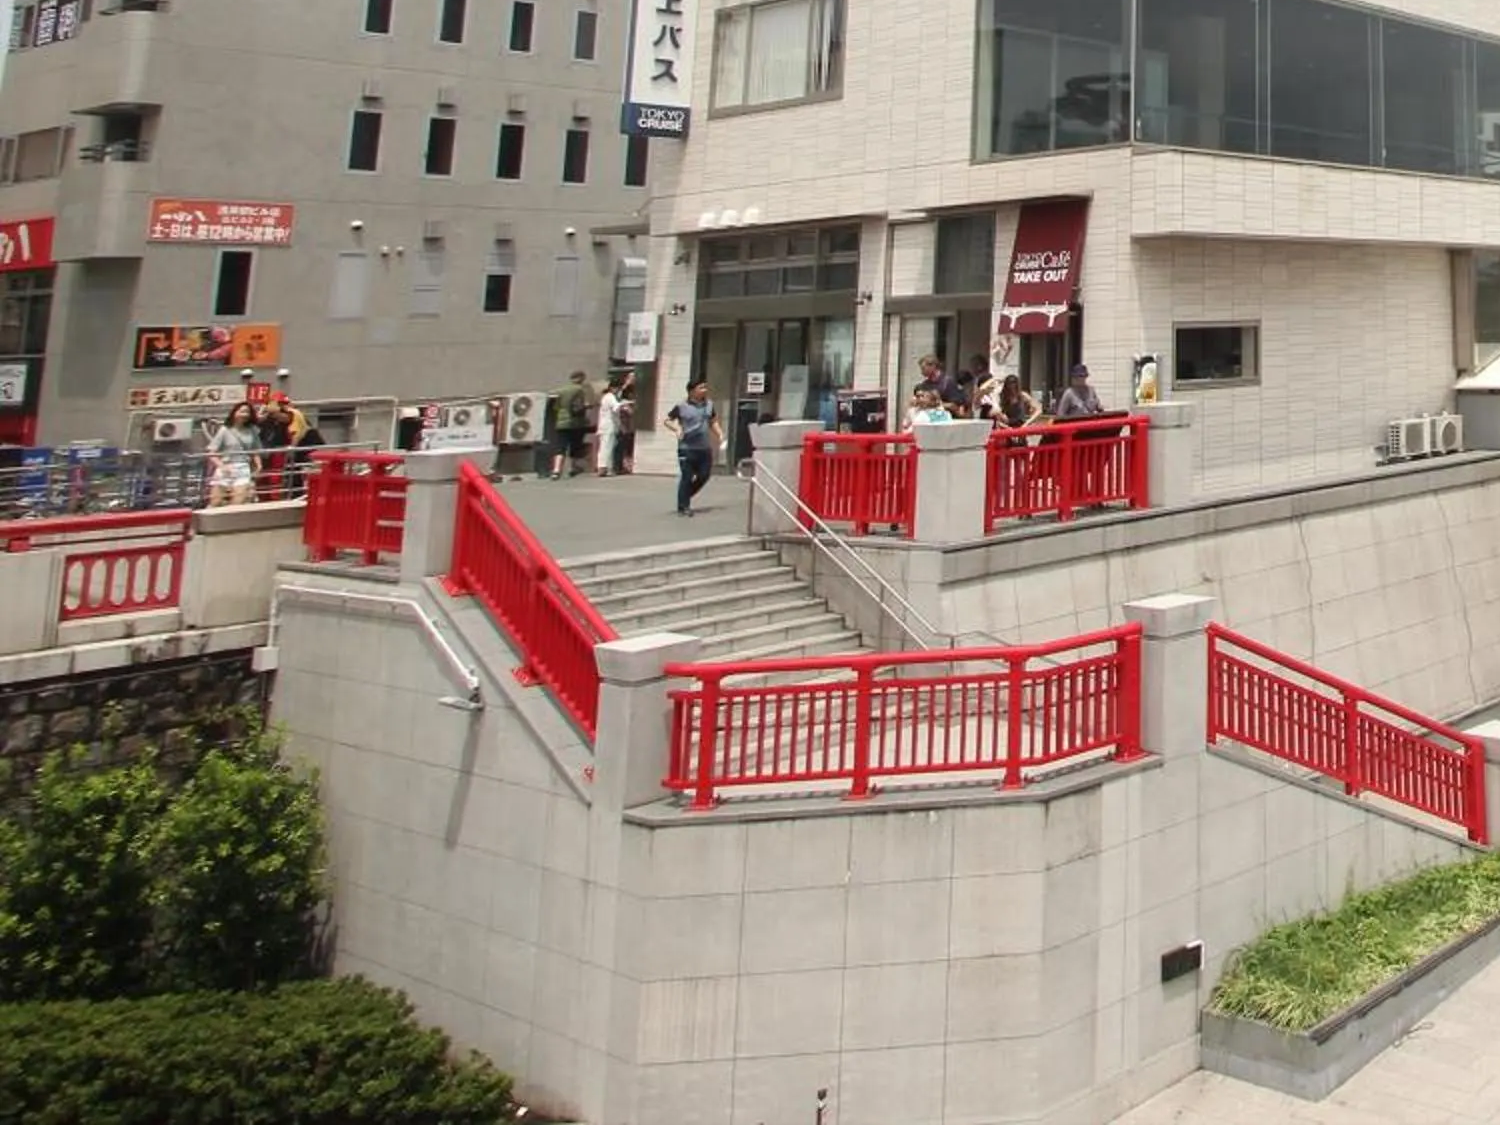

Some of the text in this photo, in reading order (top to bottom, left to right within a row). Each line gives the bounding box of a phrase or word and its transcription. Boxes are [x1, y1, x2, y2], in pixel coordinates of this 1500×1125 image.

[640, 107, 685, 122] TOKYO
[637, 118, 683, 132] CRUISE
[1013, 269, 1069, 284] TAKE OUT
